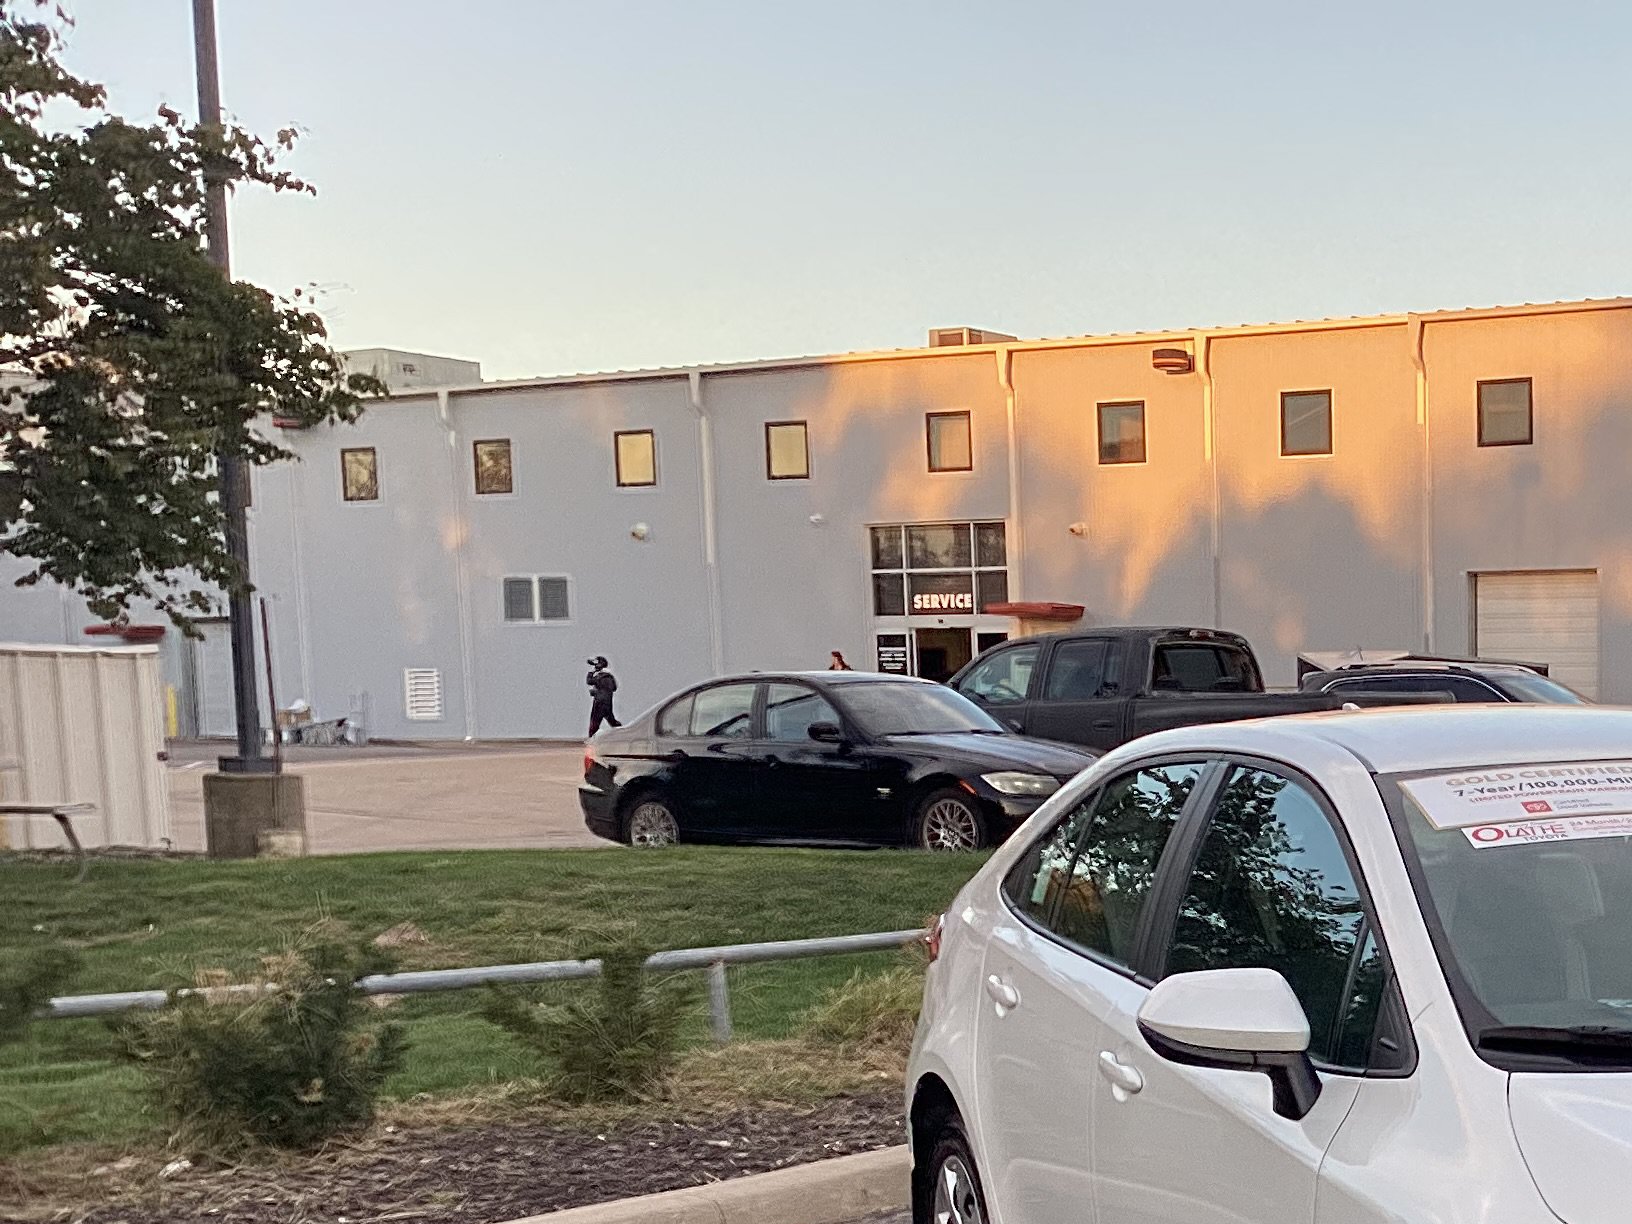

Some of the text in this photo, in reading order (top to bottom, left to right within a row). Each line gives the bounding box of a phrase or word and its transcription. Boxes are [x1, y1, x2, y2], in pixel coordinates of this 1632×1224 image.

[913, 593, 973, 610] SERVICE
[1446, 773, 1514, 786] GOLD
[1523, 833, 1568, 842] TOYOTA
